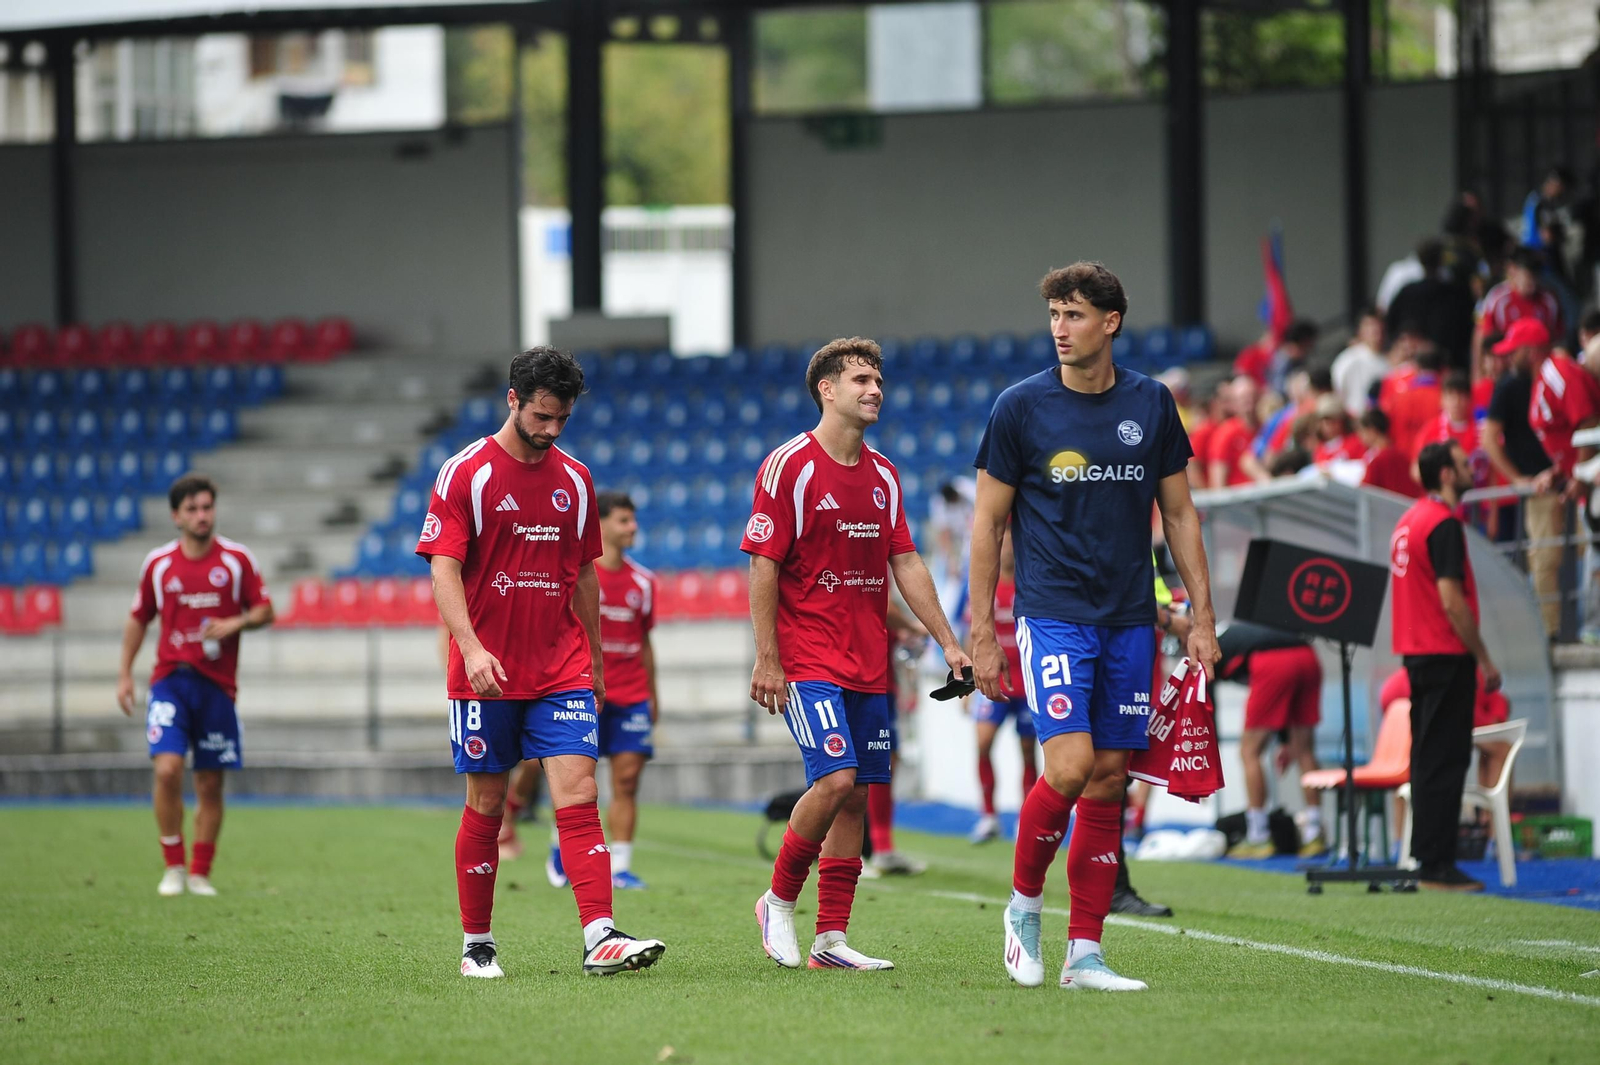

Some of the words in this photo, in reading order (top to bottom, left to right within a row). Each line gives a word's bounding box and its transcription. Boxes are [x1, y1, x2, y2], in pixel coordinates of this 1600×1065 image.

[1051, 464, 1145, 484] SOLGALEO
[1041, 653, 1072, 689] 21
[566, 700, 586, 710] BAR
[814, 699, 839, 731] 11
[466, 700, 482, 731] 8
[553, 711, 597, 724] PANCHITO
[1170, 755, 1210, 772] ANCA
